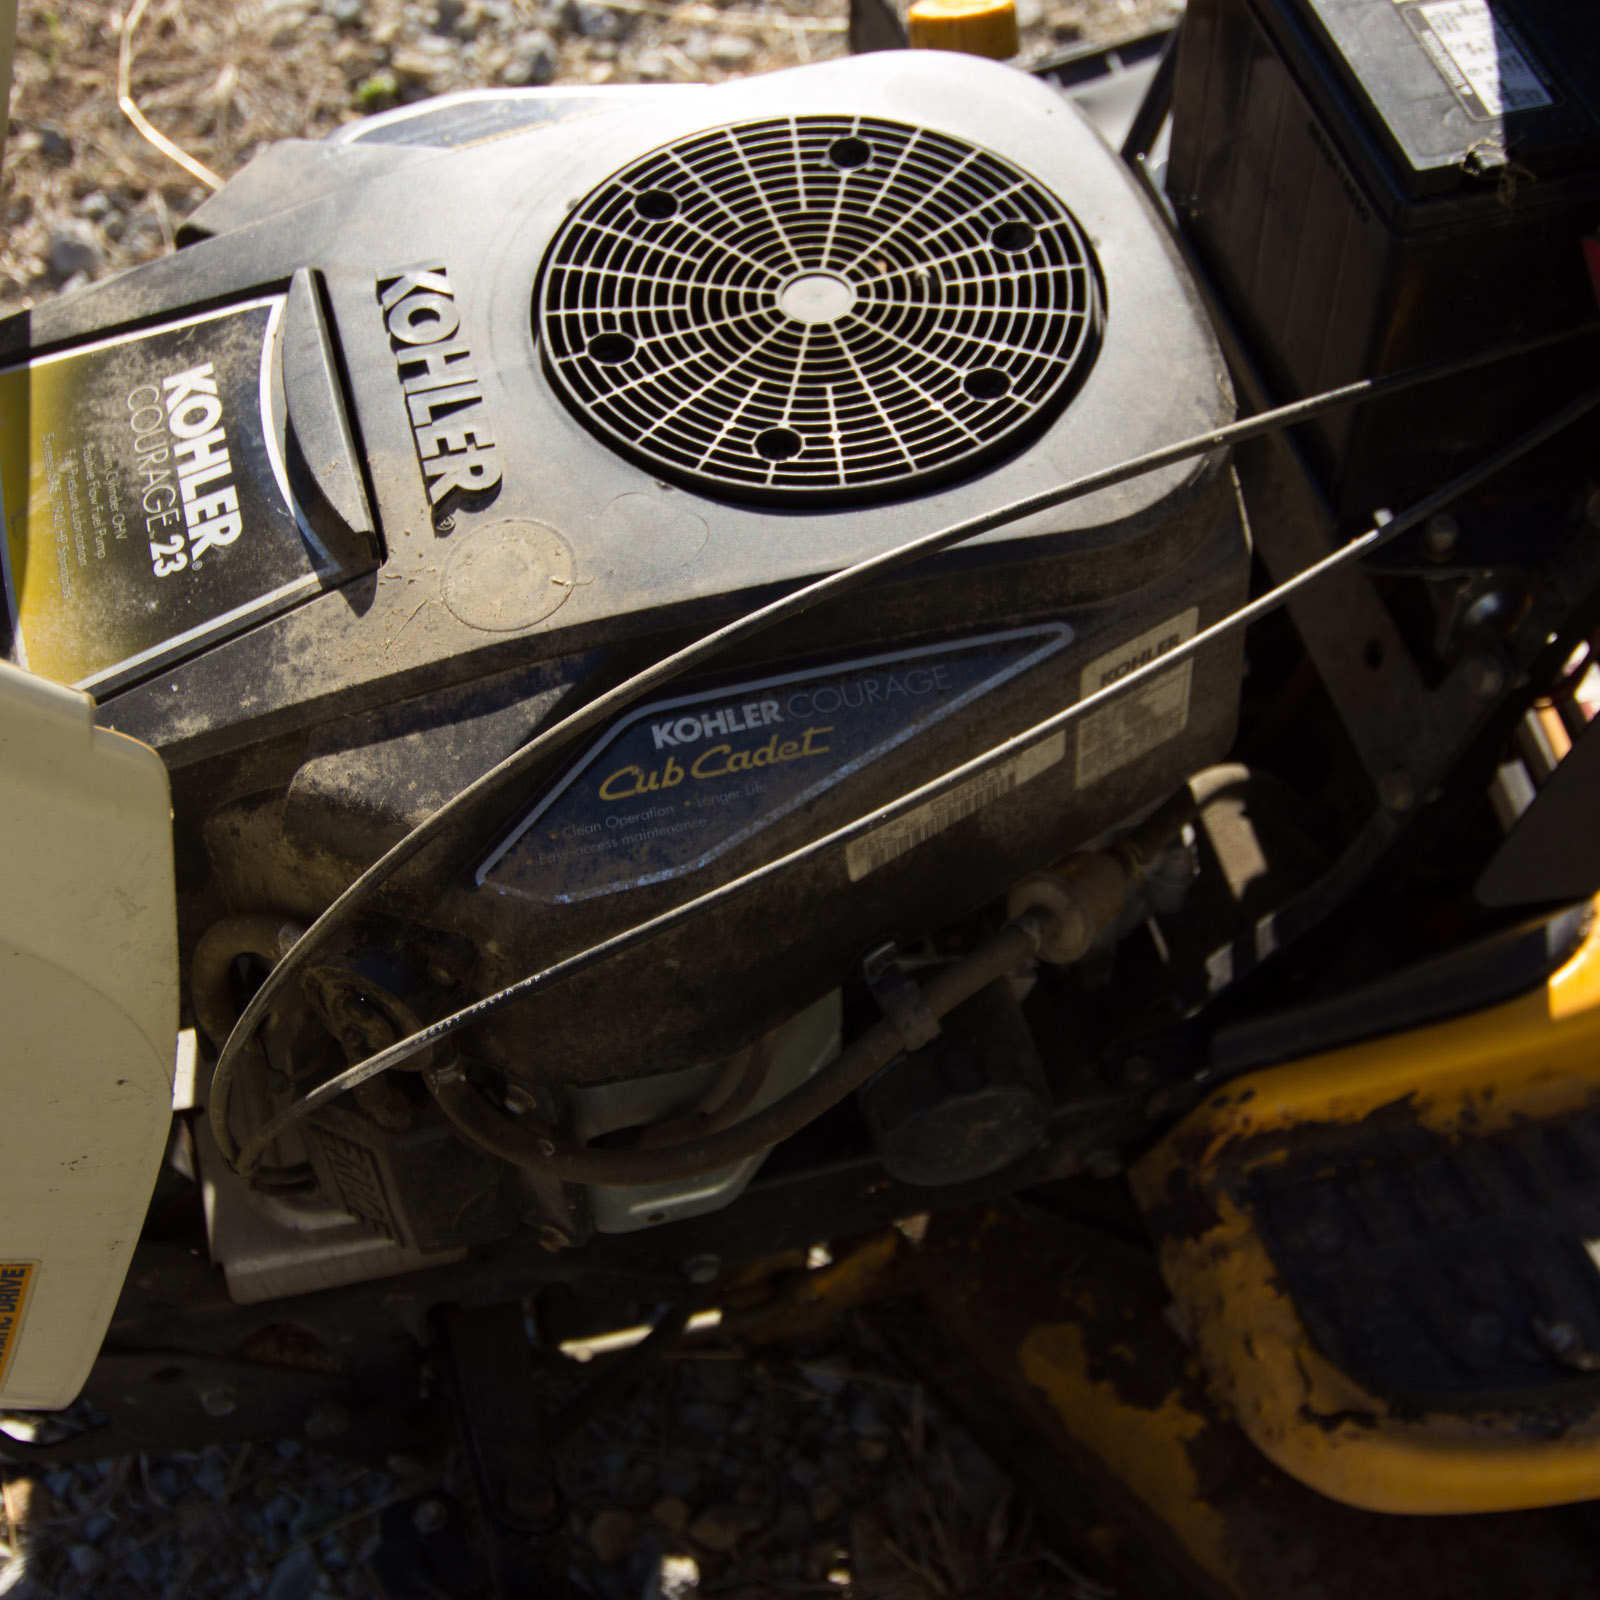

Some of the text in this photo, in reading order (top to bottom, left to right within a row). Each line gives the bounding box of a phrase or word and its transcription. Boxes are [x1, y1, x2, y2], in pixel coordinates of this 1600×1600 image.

[377, 264, 504, 510] KOHLER
[42, 434, 55, 472] Exceeds
[162, 363, 244, 561] KOHLER
[47, 475, 62, 496] SAE
[65, 469, 81, 508] Pressure
[82, 446, 107, 558] Positive Flow Fuel Pump
[104, 472, 121, 513] Cylinder
[127, 384, 188, 578] COURAGE 23
[53, 530, 67, 544] HP
[71, 512, 89, 566] Lubrication
[112, 514, 127, 539] OHV
[57, 547, 73, 599] Standards
[651, 666, 951, 750] KOHLER COURAGE
[599, 727, 833, 802] Cub Cadet
[562, 803, 675, 839] Clean Operation
[621, 817, 707, 846] maintenance
